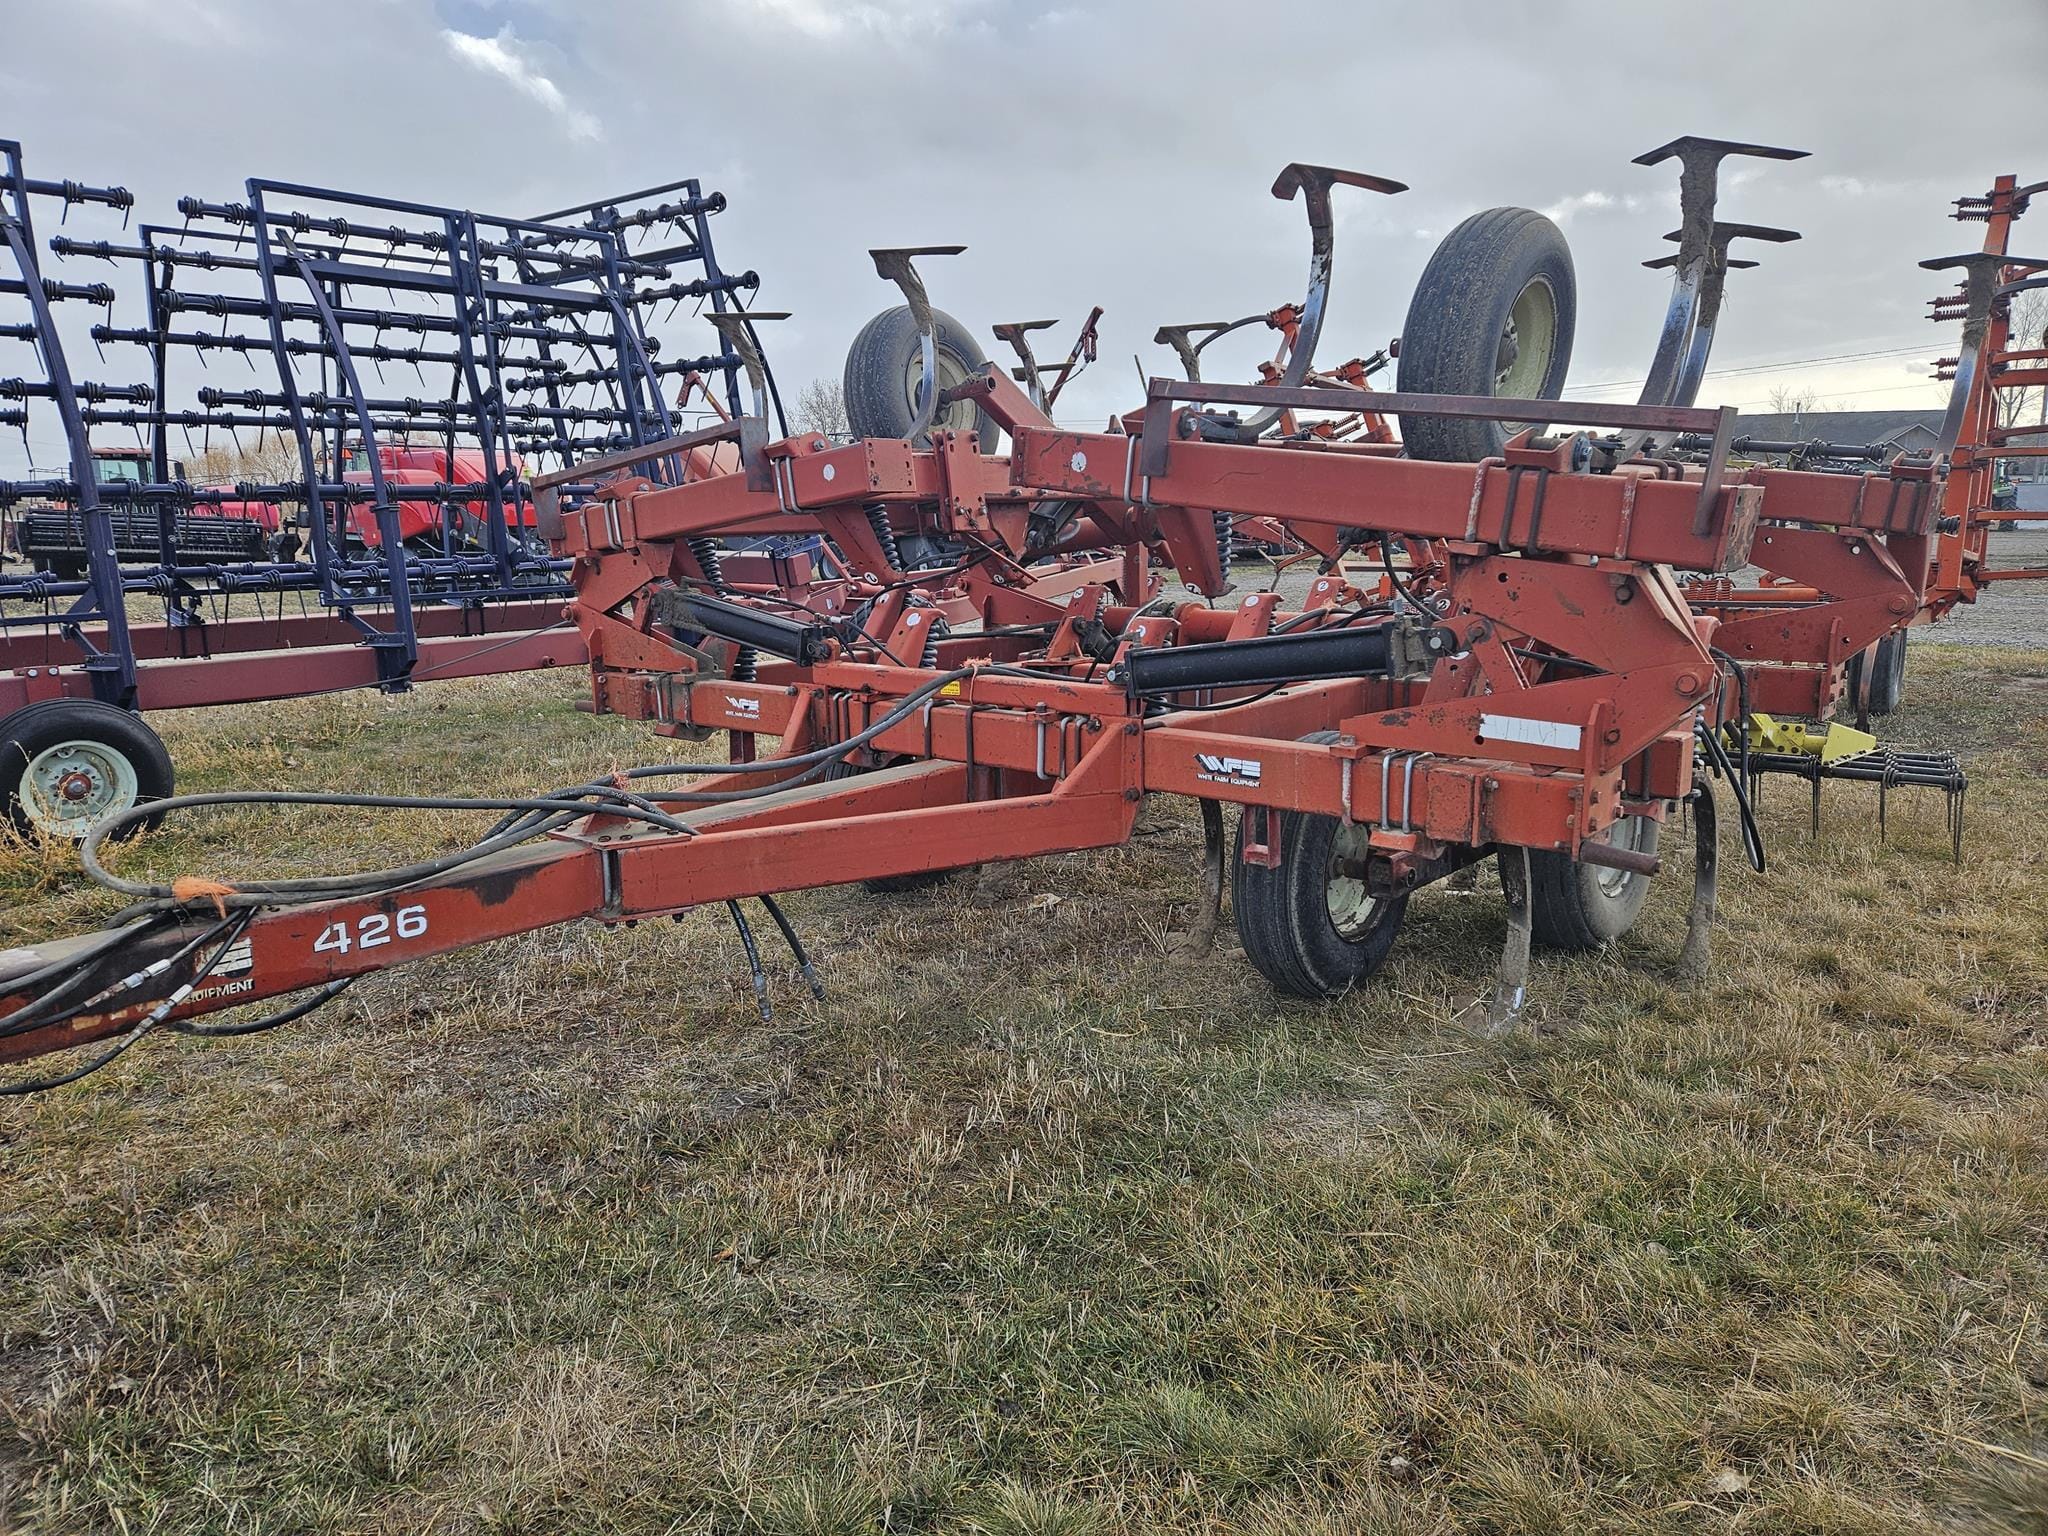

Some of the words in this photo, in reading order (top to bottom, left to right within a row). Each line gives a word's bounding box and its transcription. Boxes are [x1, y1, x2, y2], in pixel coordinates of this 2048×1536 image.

[1195, 753, 1261, 778] WFE
[1197, 772, 1213, 781] WHITE
[1214, 775, 1229, 783] FARM
[1230, 777, 1261, 788] EQUIPMENT
[313, 904, 428, 955] 426
